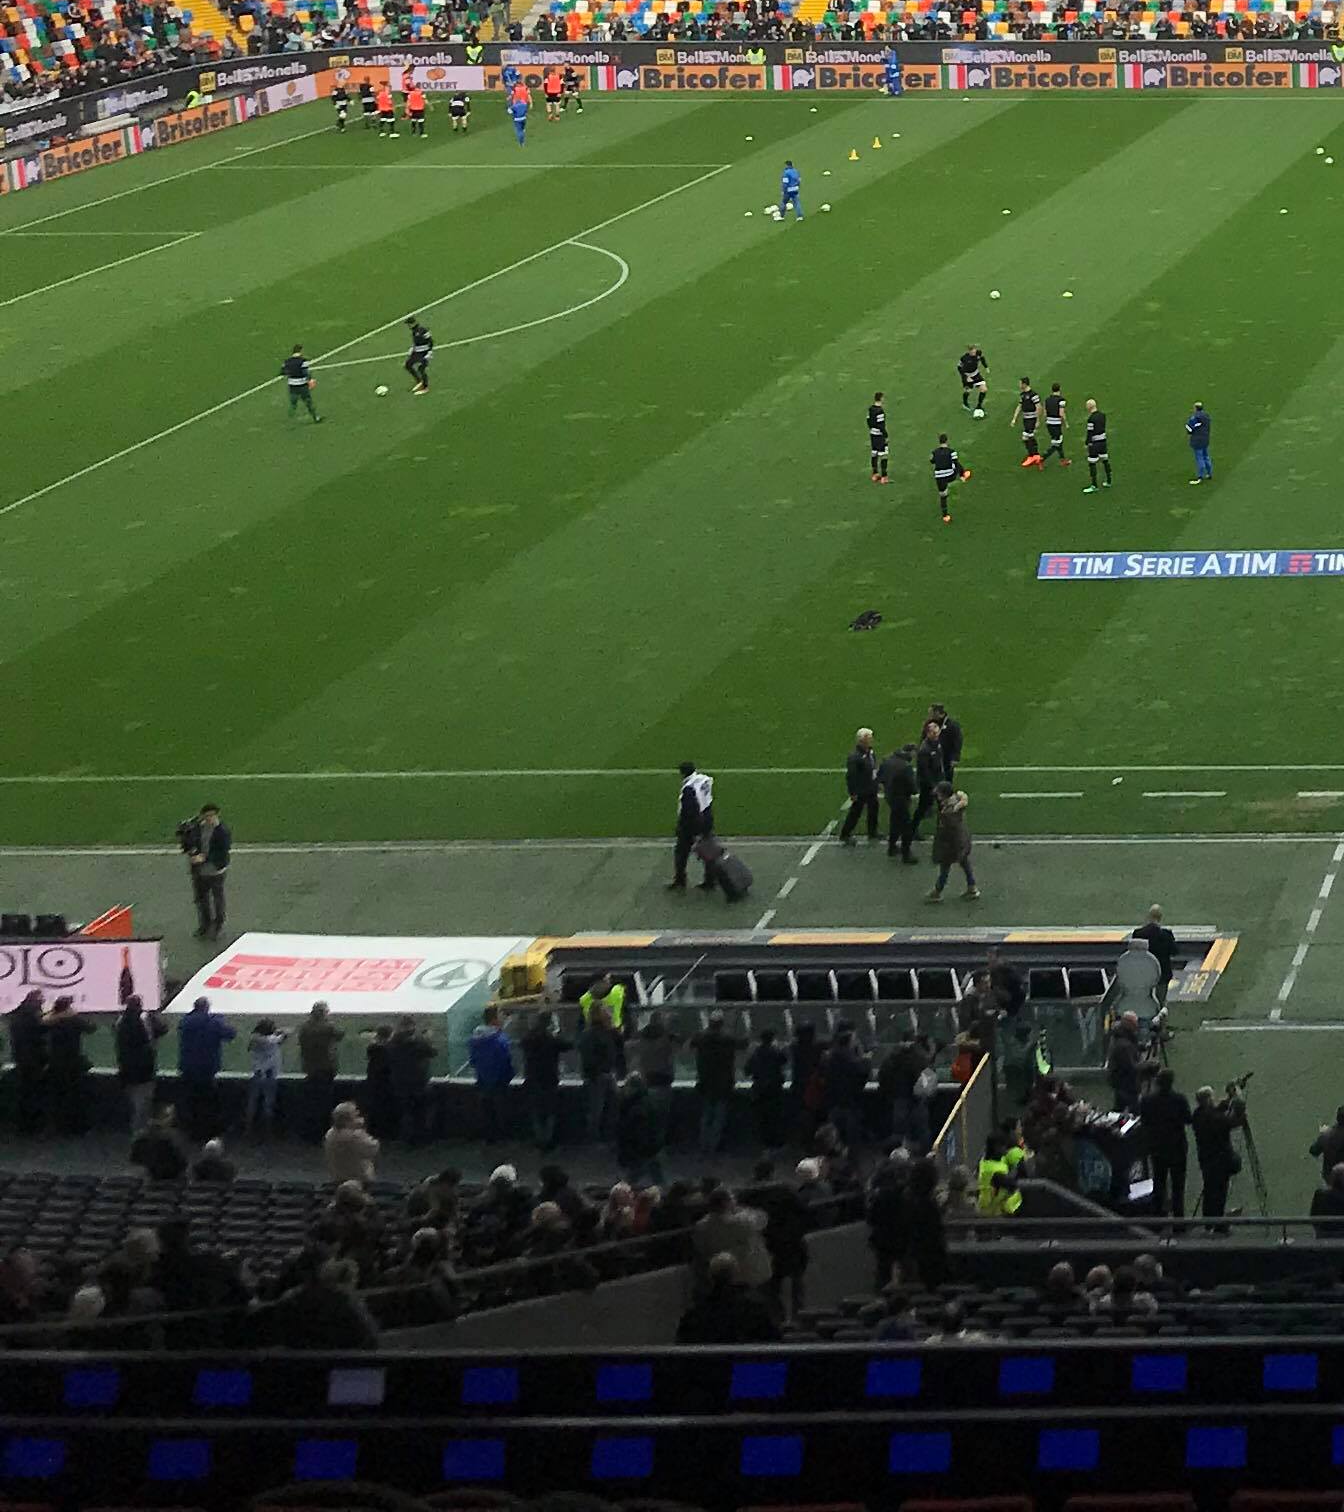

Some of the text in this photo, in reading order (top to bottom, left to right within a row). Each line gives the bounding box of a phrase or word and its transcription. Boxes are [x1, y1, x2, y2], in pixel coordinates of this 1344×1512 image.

[643, 66, 760, 88] Bricofer
[994, 65, 1111, 87] Bricofer
[1170, 64, 1287, 86] Bricofer
[157, 104, 229, 140] Bricofer
[43, 136, 122, 179] Bricofer
[1072, 557, 1114, 575] TIM
